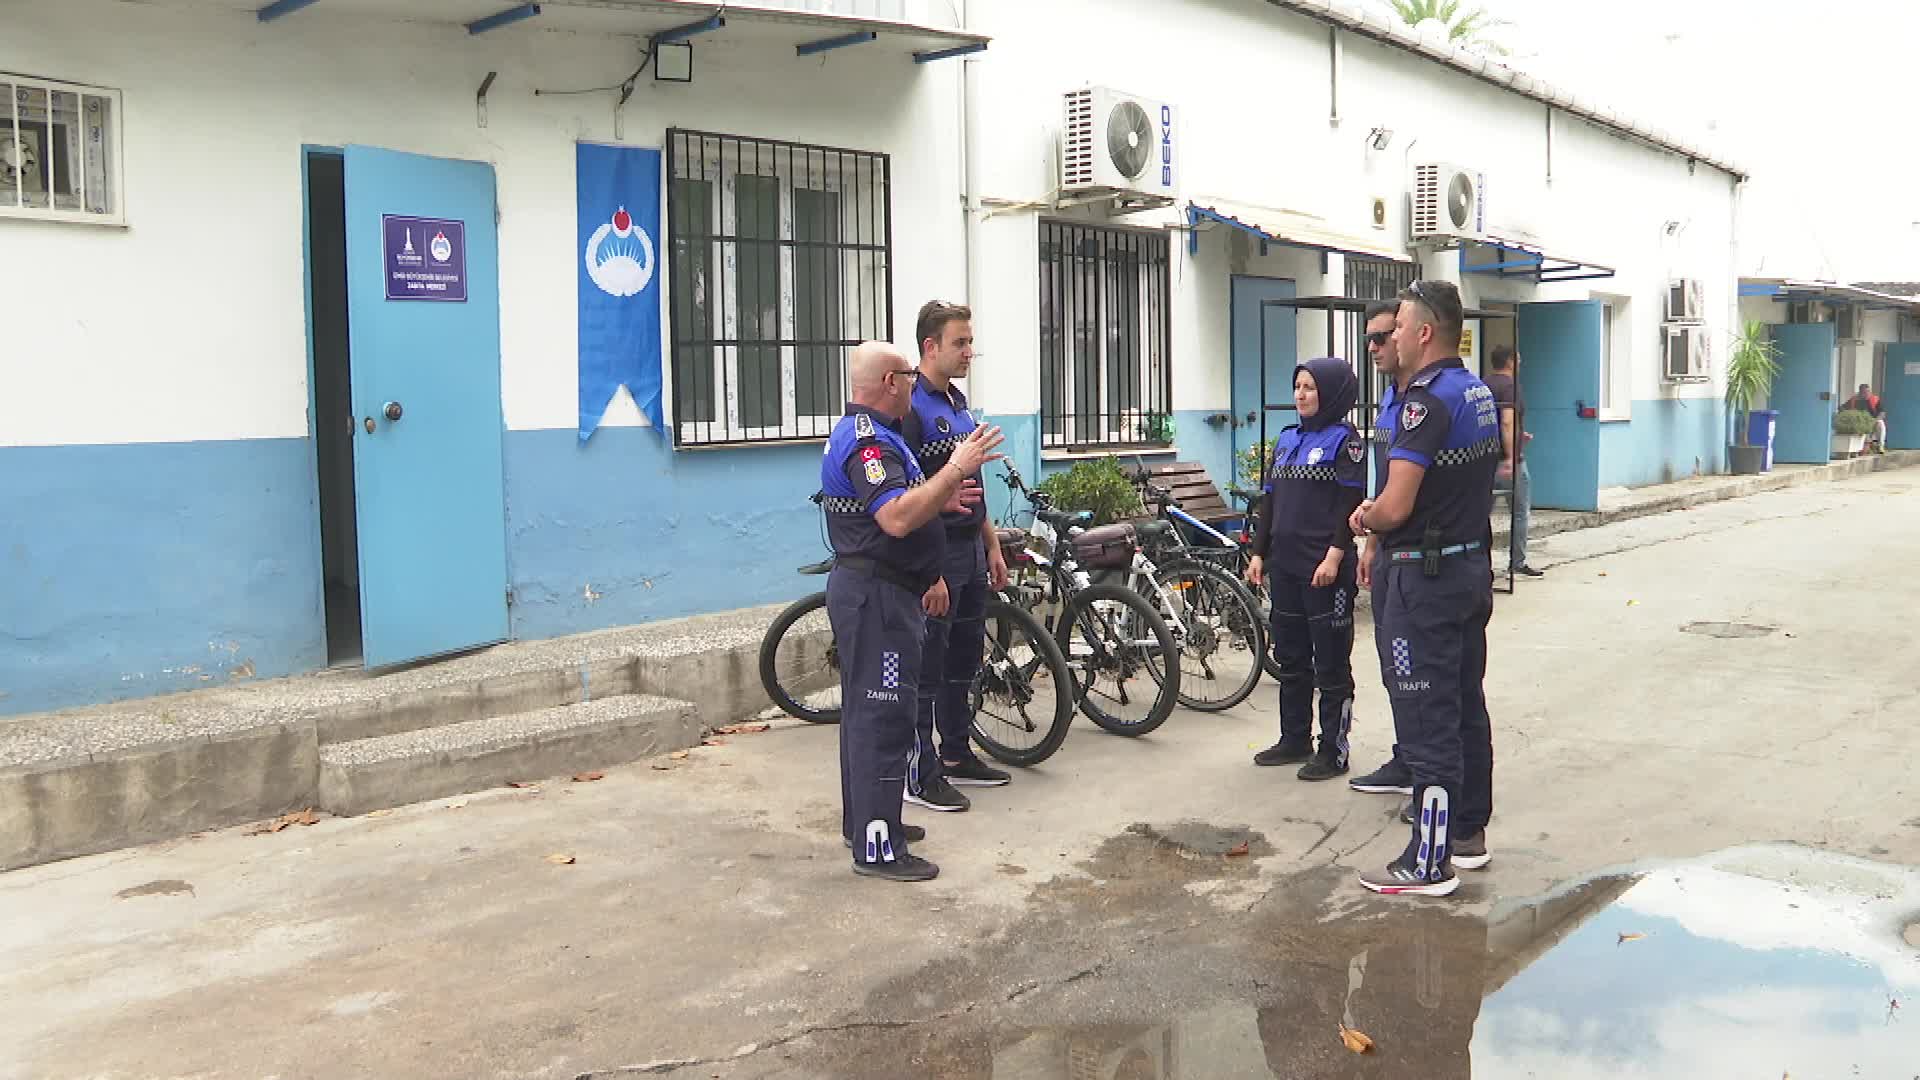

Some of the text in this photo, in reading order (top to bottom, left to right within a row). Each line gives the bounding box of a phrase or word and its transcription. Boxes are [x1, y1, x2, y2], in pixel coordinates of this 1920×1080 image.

[1161, 105, 1171, 186] BEKO
[1397, 679, 1431, 691] TRAFİK
[866, 689, 899, 703] ZABITA
